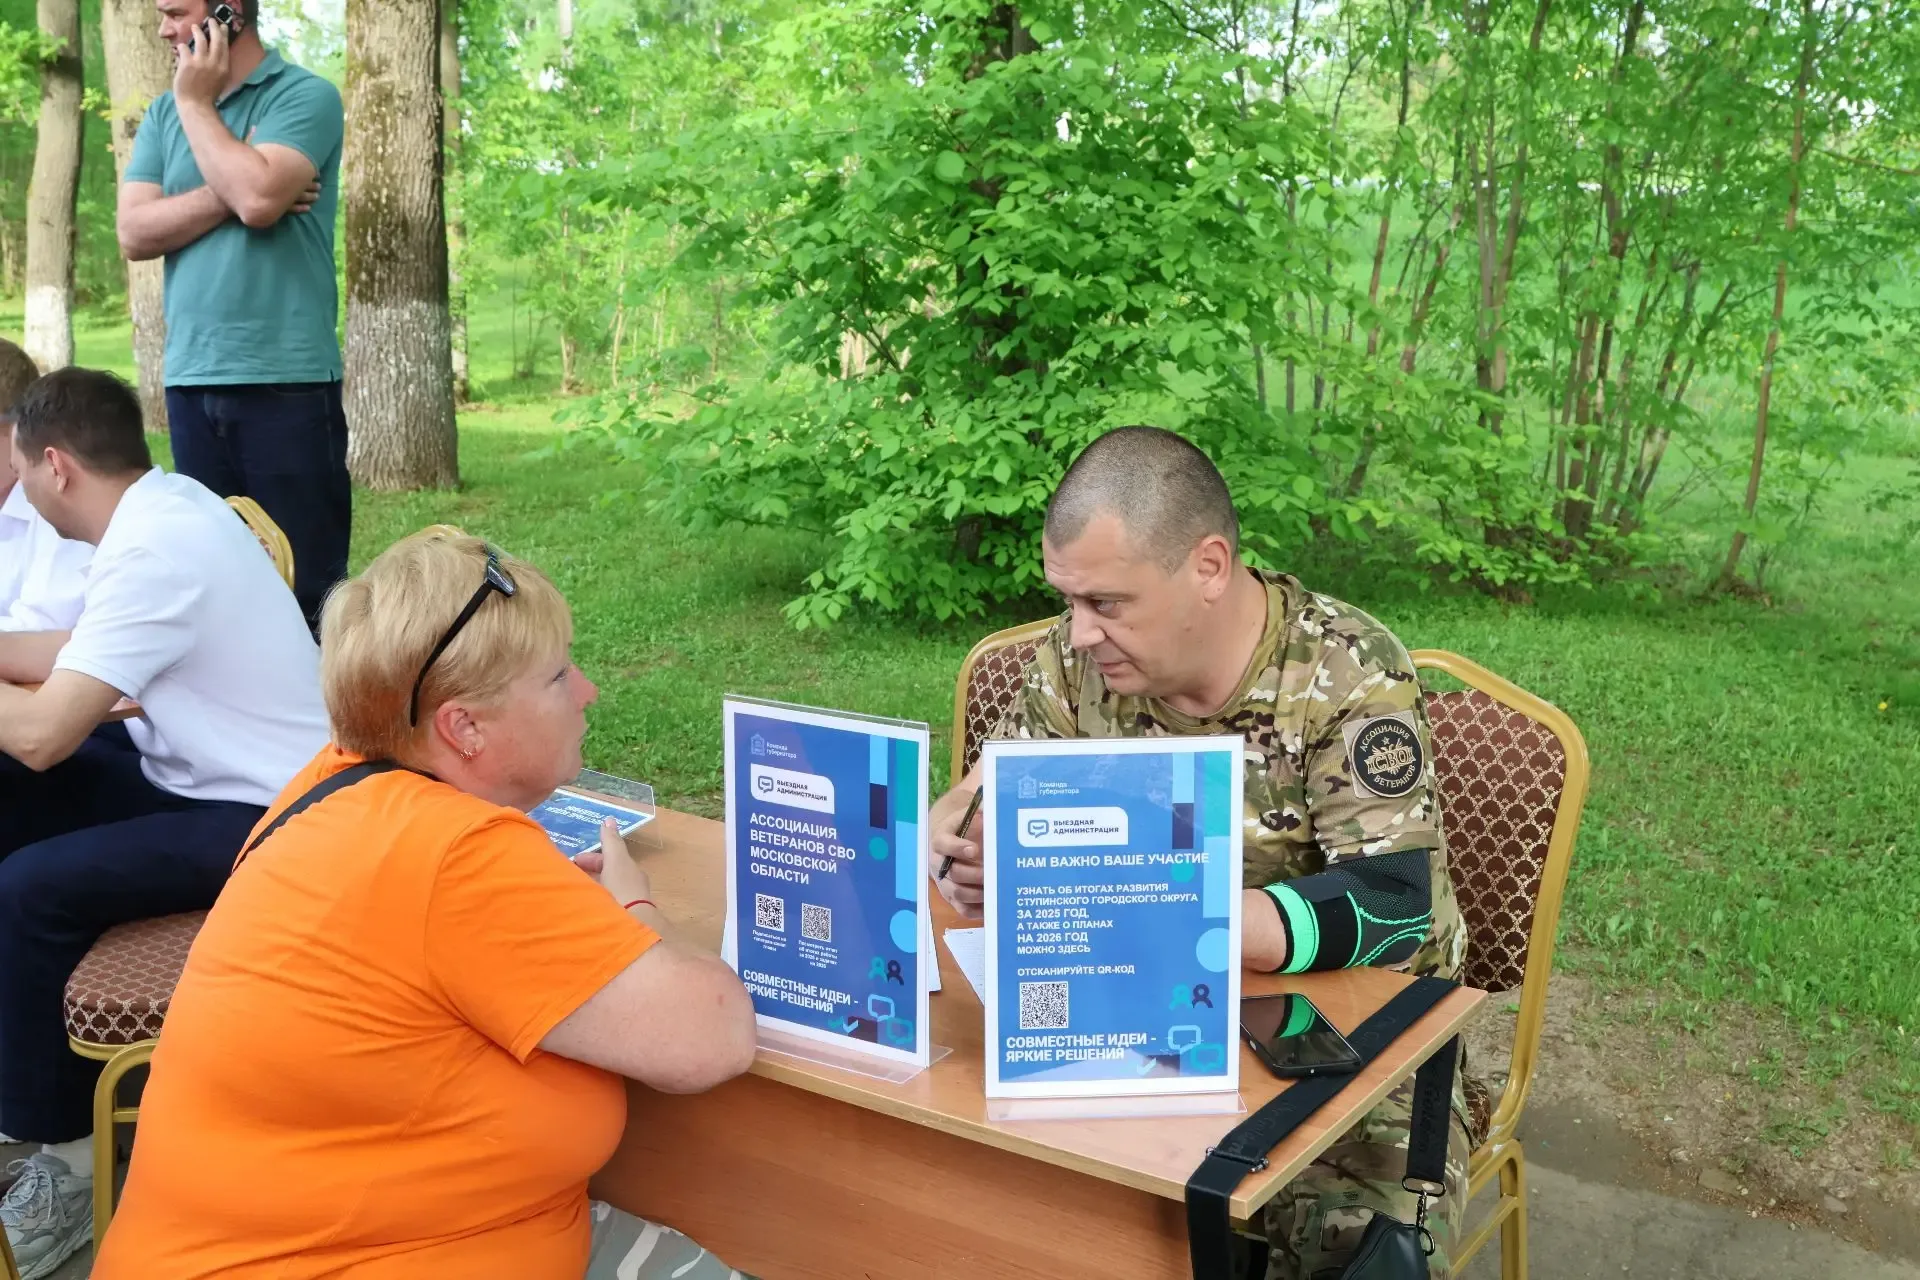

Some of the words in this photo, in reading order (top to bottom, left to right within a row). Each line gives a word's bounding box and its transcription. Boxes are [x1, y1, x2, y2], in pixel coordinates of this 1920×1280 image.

[1360, 724, 1411, 752] АССОЦИАЦИЯ
[1373, 749, 1408, 771] СВО
[1374, 764, 1416, 788] ВЕТЕРАНОВ
[776, 779, 808, 790] ВЫЕЗДНАЯ
[1039, 781, 1068, 789] Команда
[1039, 787, 1080, 796] губернатора
[776, 787, 828, 801] АДМИНИСТРАЦИЯ
[749, 812, 837, 840] АССОЦИАЦИЯ
[1053, 819, 1095, 827] ВЫЕЗДНАЯ
[1053, 827, 1119, 835] АДМИНИСТРАЦИЯ
[750, 828, 825, 854] ВЕТЕРАНОВ
[828, 844, 856, 860] СВО
[750, 845, 837, 874] МОСКОВСКОЙ
[1016, 857, 1047, 868] НАМ
[1050, 855, 1101, 868] ВАЖНО
[1104, 854, 1145, 866] ВАШЕ
[1148, 853, 1210, 865] УЧАСТИЕ
[750, 862, 809, 885] ОБЛАСТИ
[1016, 886, 1056, 896] УЗНАТЬ
[1057, 886, 1073, 894] ОБ
[1074, 885, 1114, 894] ИТОГАХ
[1116, 883, 1169, 893] РАЗВИТИЯ
[1016, 897, 1090, 907] СТУПИНСКОГО
[1091, 895, 1158, 905] ГОРОДСКОГО
[1160, 893, 1199, 903] ОКРУГА
[1016, 909, 1033, 919] ЗА
[1035, 909, 1061, 919] 2025
[1063, 908, 1090, 919] ГОД,
[1016, 922, 1025, 931] А
[1027, 922, 1061, 931] ТАКЖЕ
[1062, 921, 1070, 929] О
[1072, 920, 1114, 929] ПЛАНАХ
[1017, 934, 1034, 943] НА
[1036, 933, 1062, 943] 2026
[1064, 932, 1089, 942] ГОД
[1017, 945, 1056, 955] МОЖНО
[1057, 945, 1091, 954] ЗДЕСЬ
[1017, 965, 1095, 977] ОТСКАНИРУЙТЕ
[1097, 965, 1135, 975] QR-КОД
[743, 969, 818, 997] СОВМЕСТНЫЕ
[819, 987, 851, 1006] ИДЕИ
[743, 981, 779, 1001] ЯРКИЕ
[780, 990, 834, 1014] РЕШЕНИЯ
[1006, 1034, 1105, 1048] СОВМЕСТНЫЕ
[1107, 1033, 1147, 1047] ИДЕИ
[1006, 1049, 1052, 1062] ЯРКИЕ
[1055, 1048, 1125, 1061] РЕШЕНИЯ
